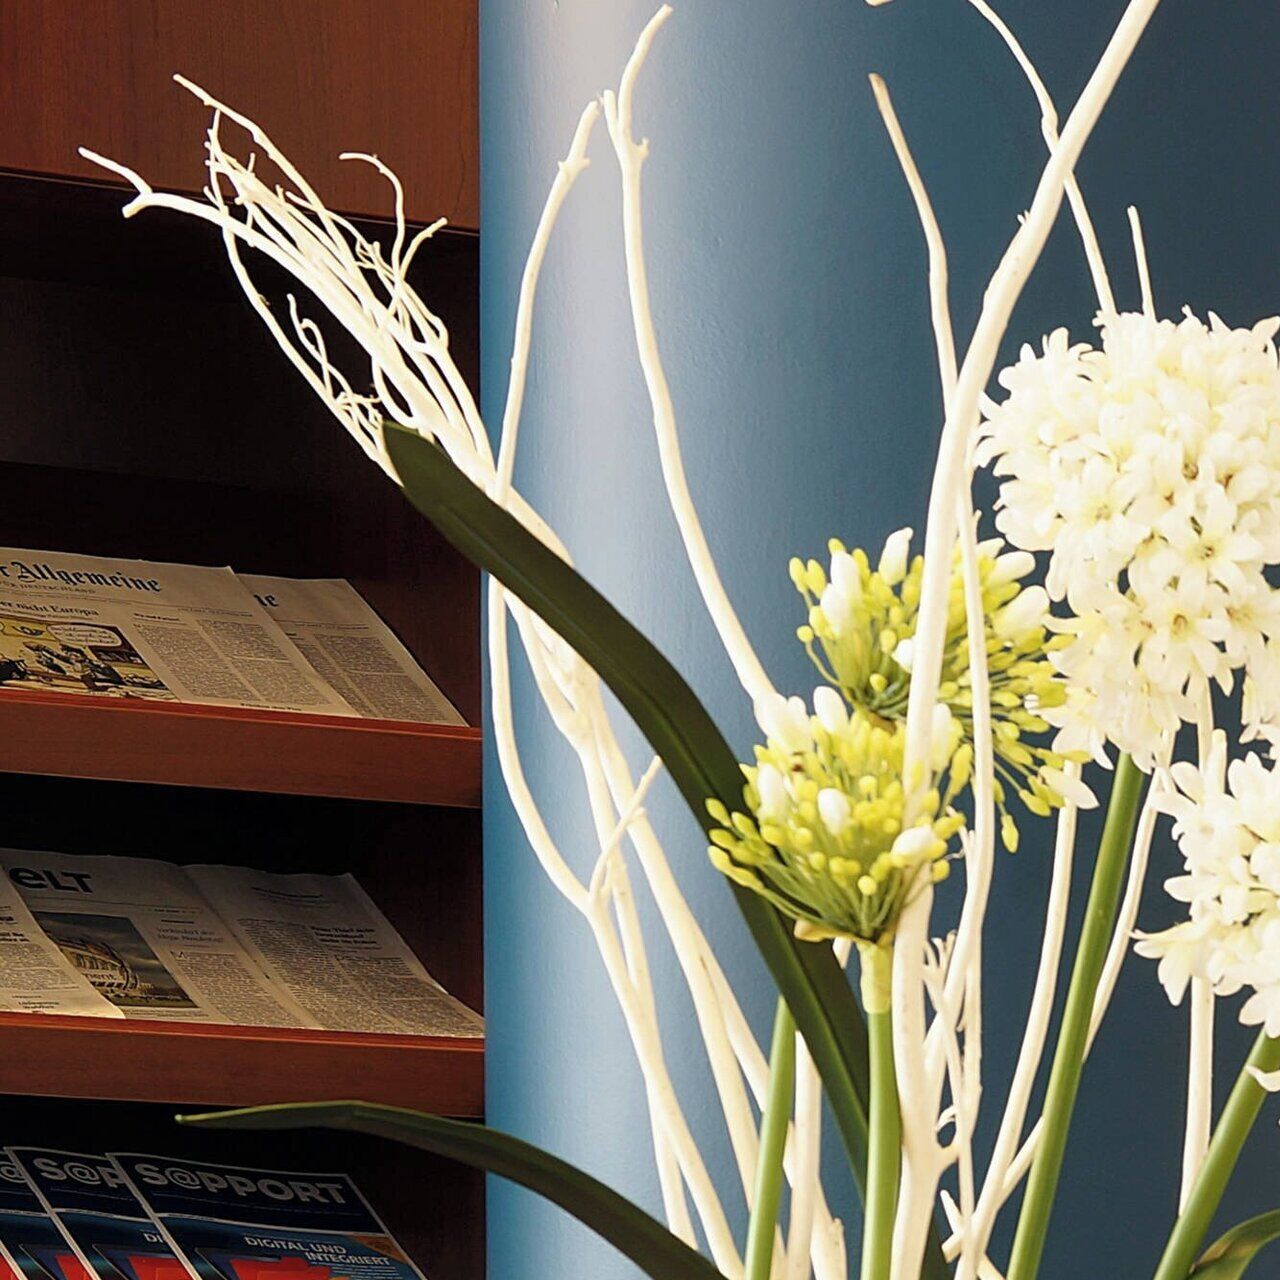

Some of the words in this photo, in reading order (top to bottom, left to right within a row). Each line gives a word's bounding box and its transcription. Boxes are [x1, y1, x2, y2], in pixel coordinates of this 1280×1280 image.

[11, 561, 162, 592] Allgemeine
[50, 604, 99, 616] Europa
[9, 867, 94, 894] eLT
[135, 1163, 344, 1203] S@PPORT
[244, 1236, 305, 1251] DIGITAL
[310, 1243, 346, 1255] UND
[305, 1253, 390, 1265] INTEGRIERT
